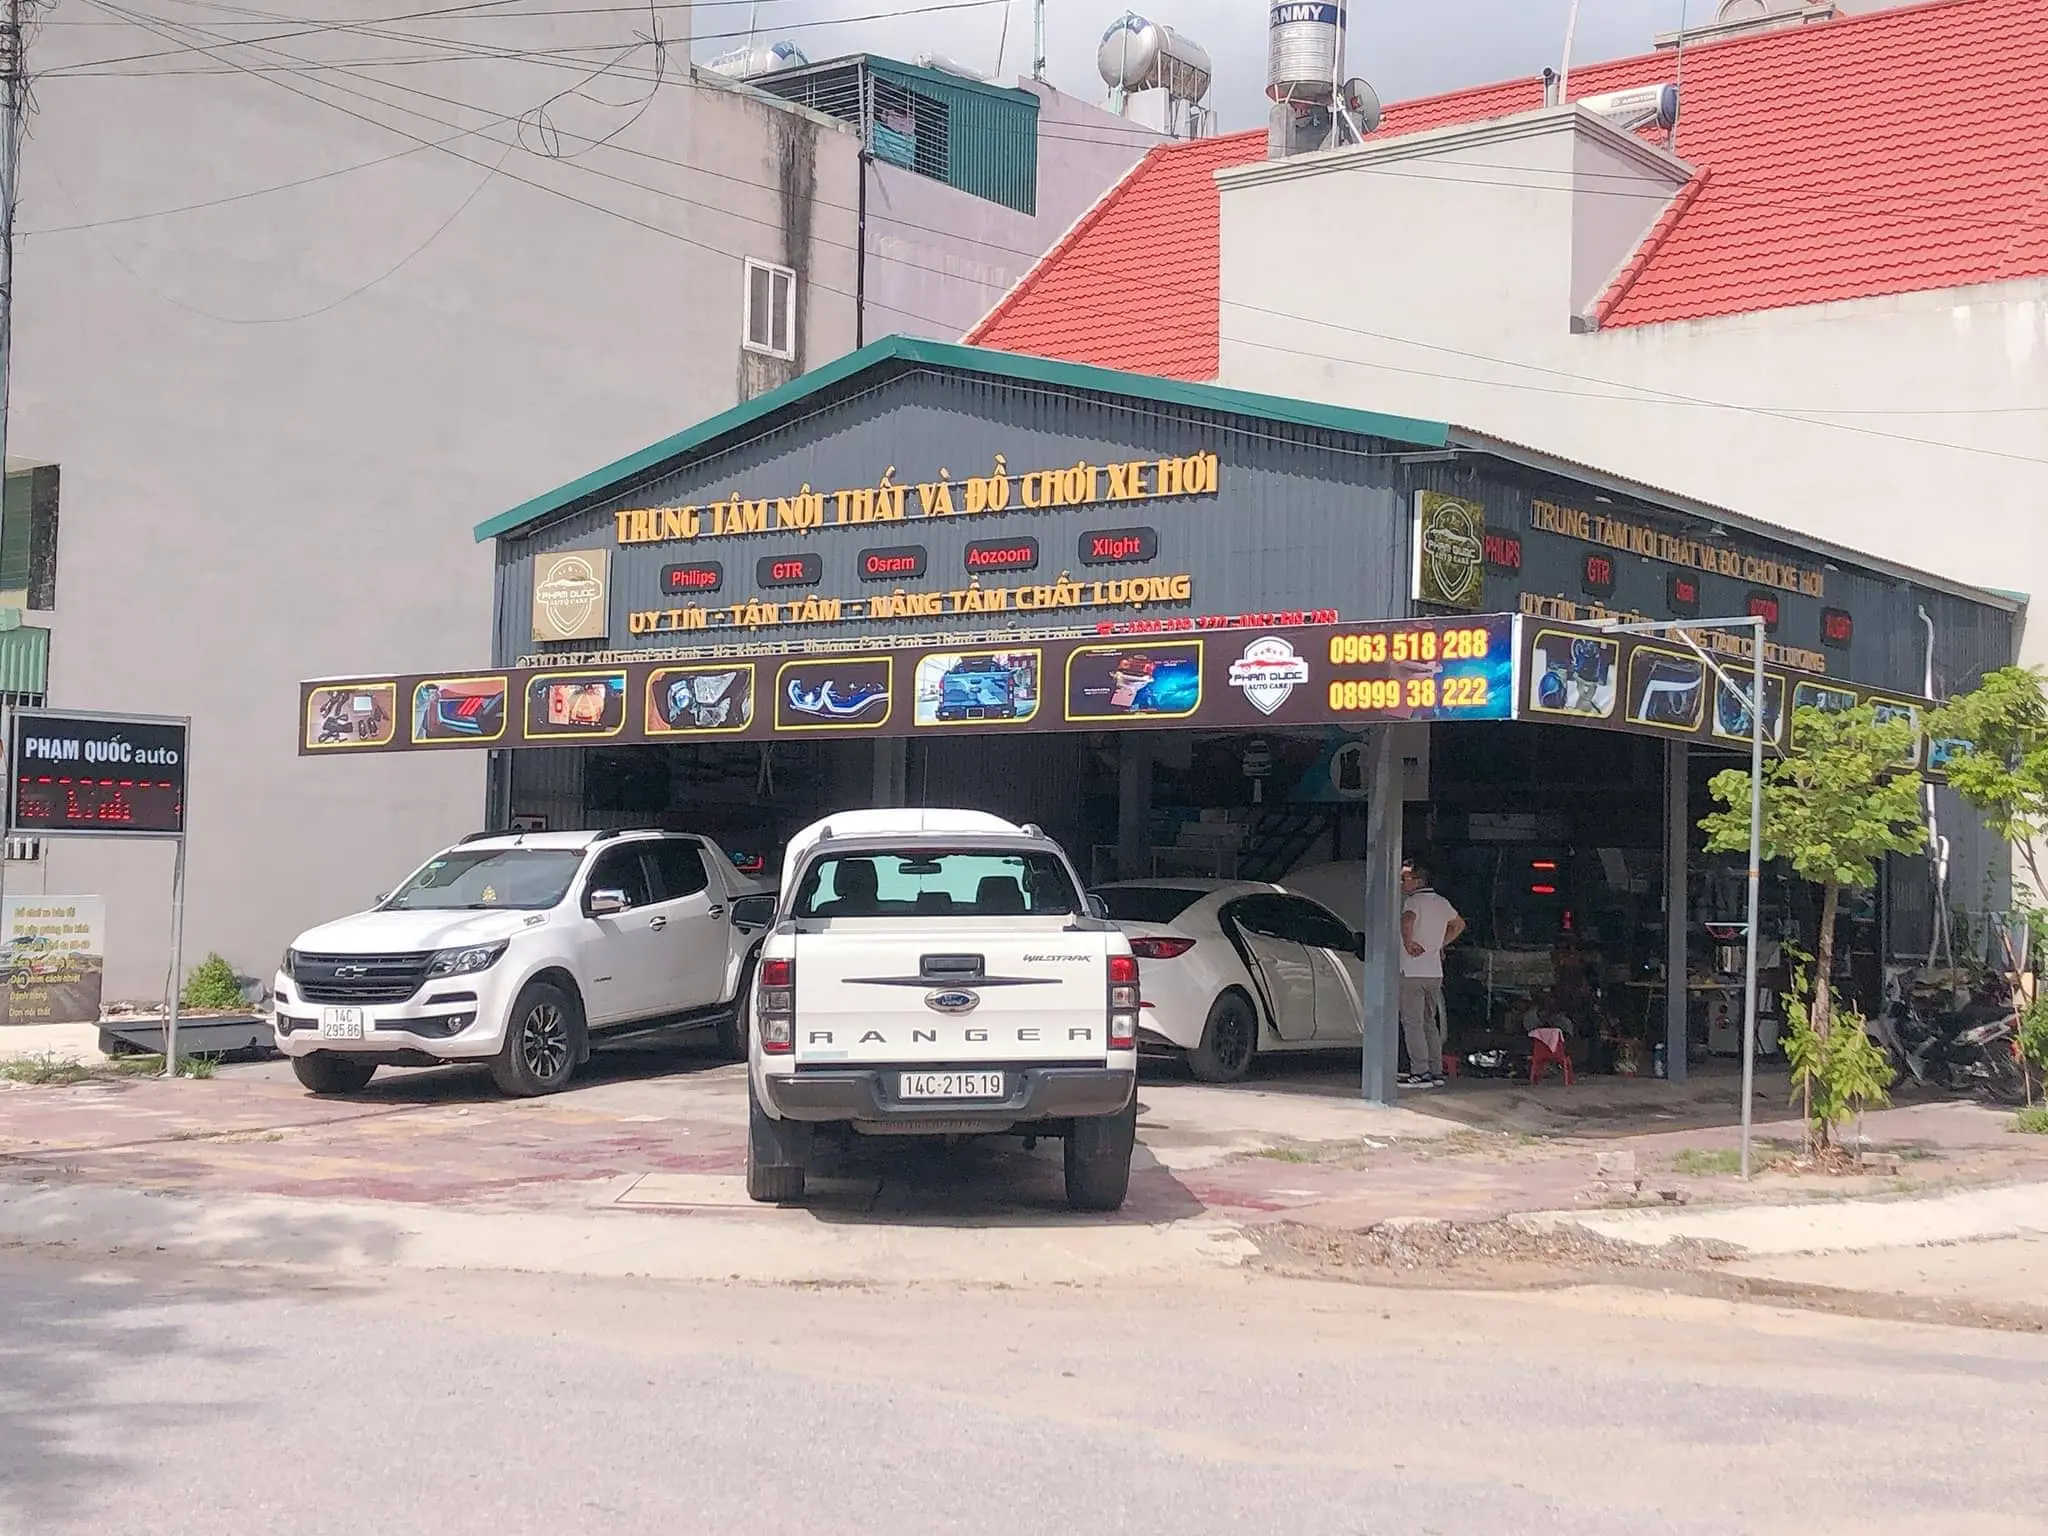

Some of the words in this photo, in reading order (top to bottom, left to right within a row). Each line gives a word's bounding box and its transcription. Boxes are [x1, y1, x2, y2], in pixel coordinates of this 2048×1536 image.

[615, 506, 699, 543] TRUNG
[710, 491, 769, 535] TÂM
[775, 482, 823, 536] NỘI
[834, 464, 907, 528] THẤT
[917, 466, 954, 517] VÀ
[964, 454, 1010, 514] ĐỒ
[1022, 460, 1097, 509] CHƠI
[1105, 460, 1150, 501] XE
[1158, 448, 1218, 496] HƠI
[1531, 499, 1590, 540] TRUNG
[967, 546, 1031, 566] Aozoom
[1092, 537, 1141, 559] Xlight
[772, 562, 804, 580] GTR
[866, 556, 915, 573] Osram
[1587, 557, 1610, 584] GTR
[671, 569, 717, 588] Philips
[629, 611, 661, 634] UY
[670, 600, 707, 630] TÍN
[730, 597, 778, 631] TẬN
[788, 594, 841, 622] TÂM
[870, 588, 942, 618] NÂNG
[1015, 569, 1085, 609] CHẤT
[1093, 574, 1192, 609] LƯỢNG
[1329, 634, 1387, 665] 0963
[1391, 631, 1436, 663] 518
[1442, 628, 1488, 660] 288
[1329, 679, 1400, 711] 08999
[1406, 678, 1436, 709] 38
[1441, 675, 1488, 706] 222
[25, 737, 79, 764] PHẠM
[84, 734, 131, 763] QUỐC
[134, 747, 179, 765] auto
[335, 1008, 353, 1023] 14C
[809, 1028, 1092, 1044] RANGER
